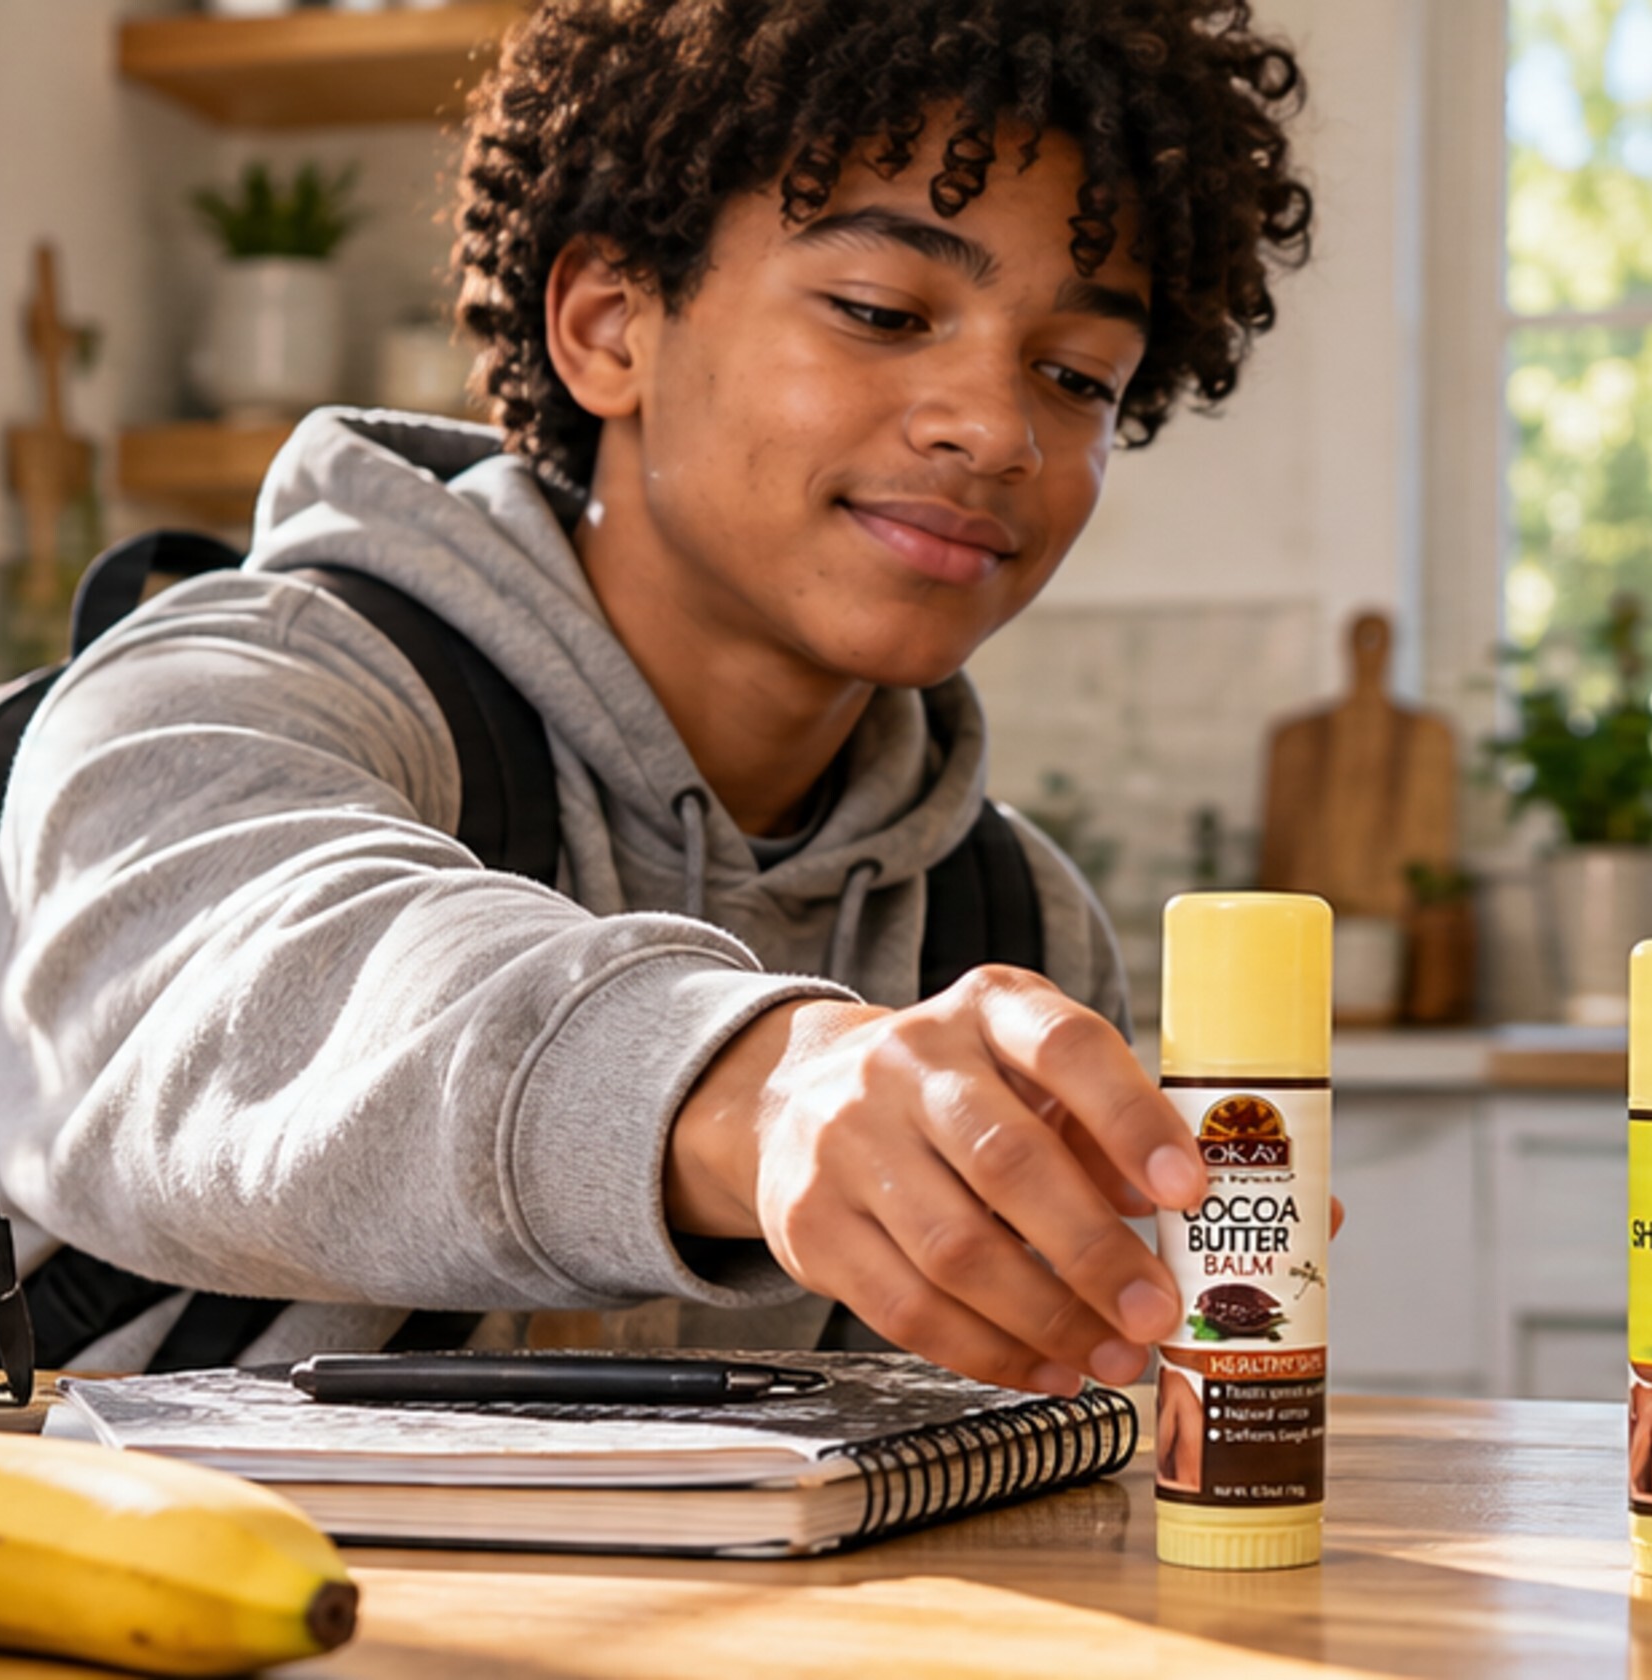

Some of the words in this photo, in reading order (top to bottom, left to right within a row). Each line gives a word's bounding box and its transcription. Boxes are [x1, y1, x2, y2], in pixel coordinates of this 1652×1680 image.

[1204, 1143, 1284, 1164] OKAY
[1188, 1225, 1289, 1252] BUTTER
[1204, 1254, 1274, 1276] BALM
